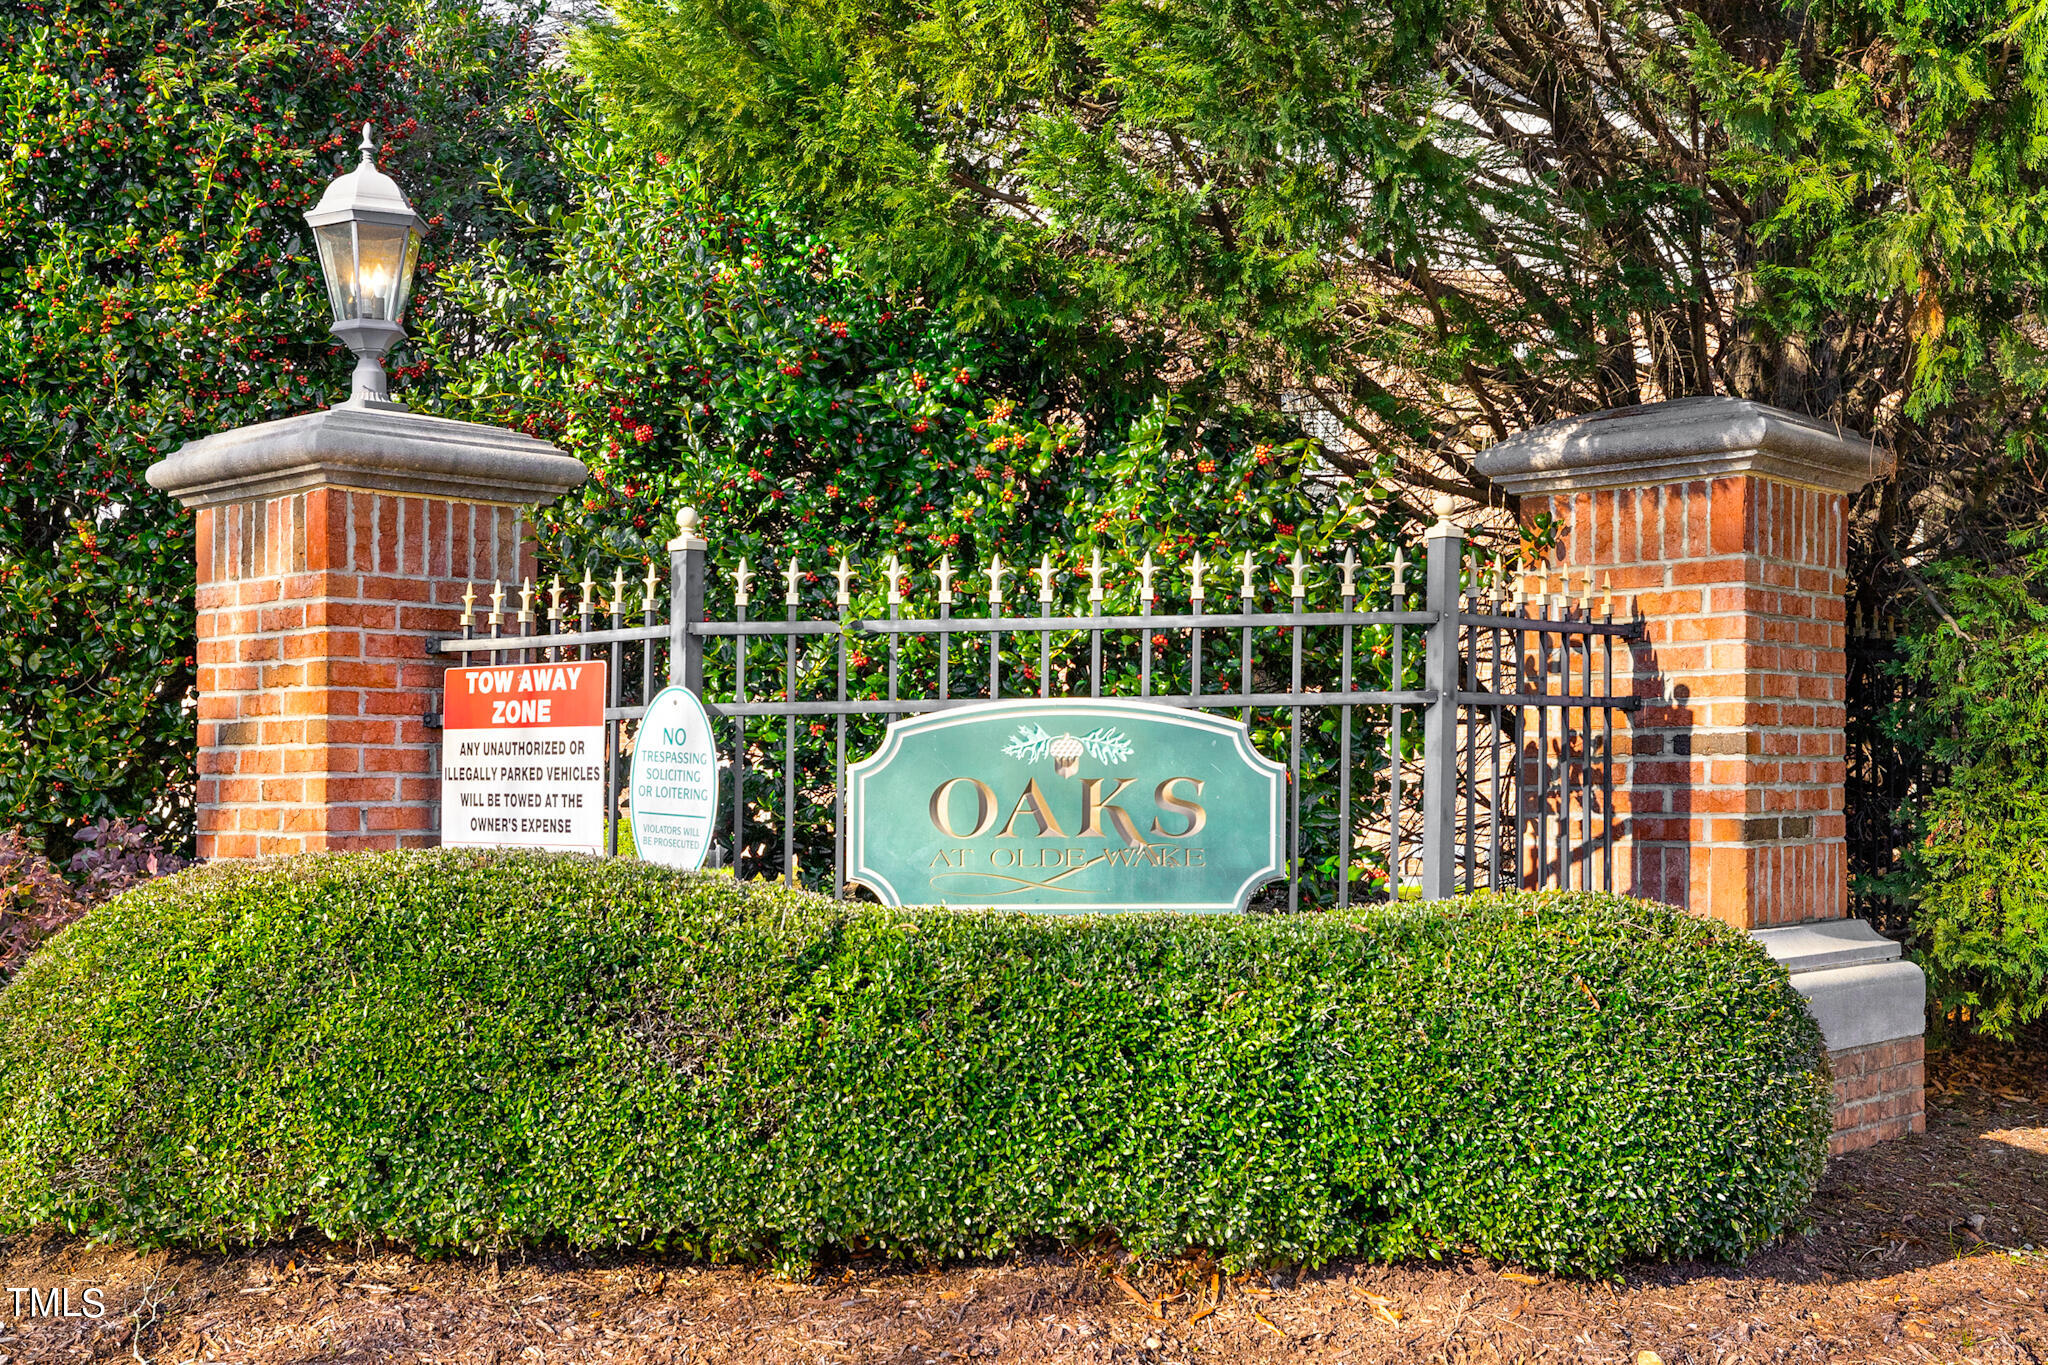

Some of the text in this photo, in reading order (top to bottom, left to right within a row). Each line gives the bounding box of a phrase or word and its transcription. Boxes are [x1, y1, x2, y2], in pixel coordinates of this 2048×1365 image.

[465, 667, 582, 694] TOW AWAY
[491, 699, 552, 724] ZONE
[663, 727, 687, 746] NO
[460, 740, 585, 756] ANY UNAUTHORIZED OR
[641, 750, 707, 766] TRESPASSING
[444, 766, 600, 781] ILLEGALLY PARKED VEHICLES
[646, 768, 701, 783] SOLICITING
[460, 793, 583, 808] WILL BE TOWED AT THE
[638, 785, 708, 801] OR LOITERING
[929, 776, 1207, 840] OAKS
[470, 817, 571, 833] OWNER'S EXPENSE
[643, 823, 700, 837] VIOLATORS WILL
[643, 836, 700, 850] BE PROSECUTED
[929, 848, 1207, 868] AT OLDE WAKE
